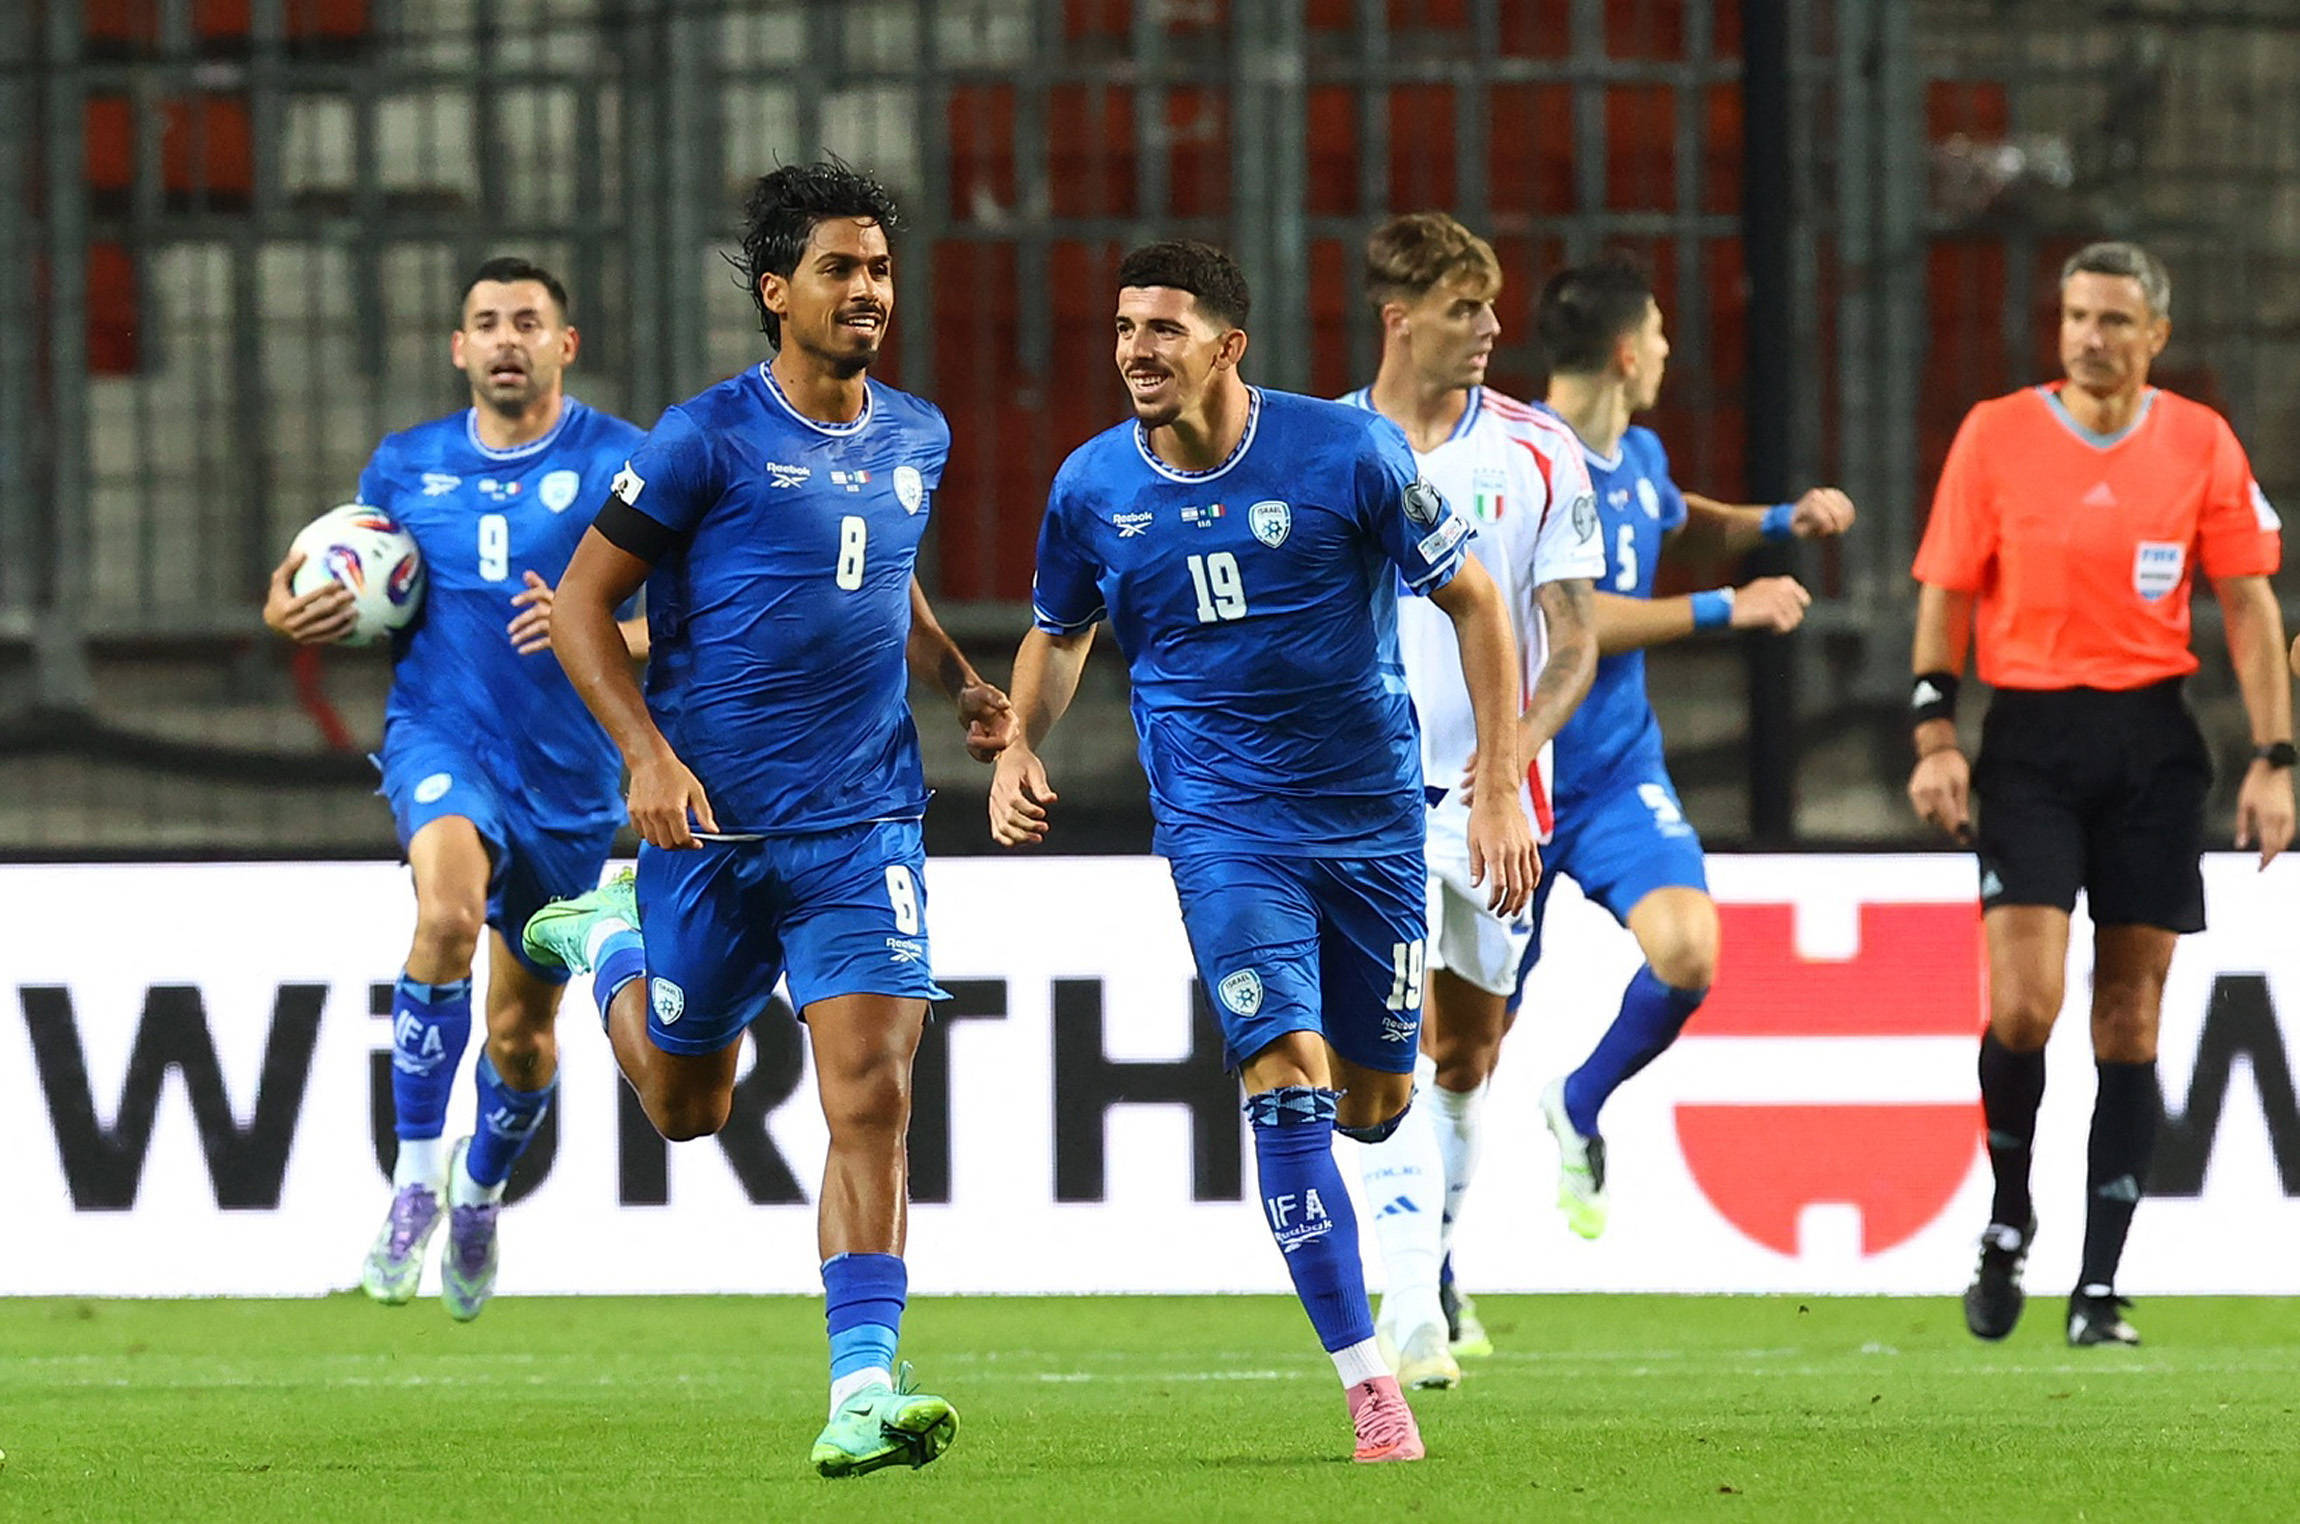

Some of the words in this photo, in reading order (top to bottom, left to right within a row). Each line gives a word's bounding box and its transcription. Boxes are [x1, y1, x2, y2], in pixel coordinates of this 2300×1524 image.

[766, 462, 811, 477] Reebok
[1112, 511, 1153, 524] Reebok
[1256, 506, 1282, 515] ISRAEL
[478, 514, 509, 582] 9
[836, 515, 867, 591] 8
[1616, 523, 1638, 592] 5
[1187, 552, 1247, 623] 19
[885, 864, 920, 936] 8
[1224, 973, 1251, 989] ISRAEL
[1386, 937, 1424, 1011] 19
[1267, 1188, 1328, 1231] IFA
